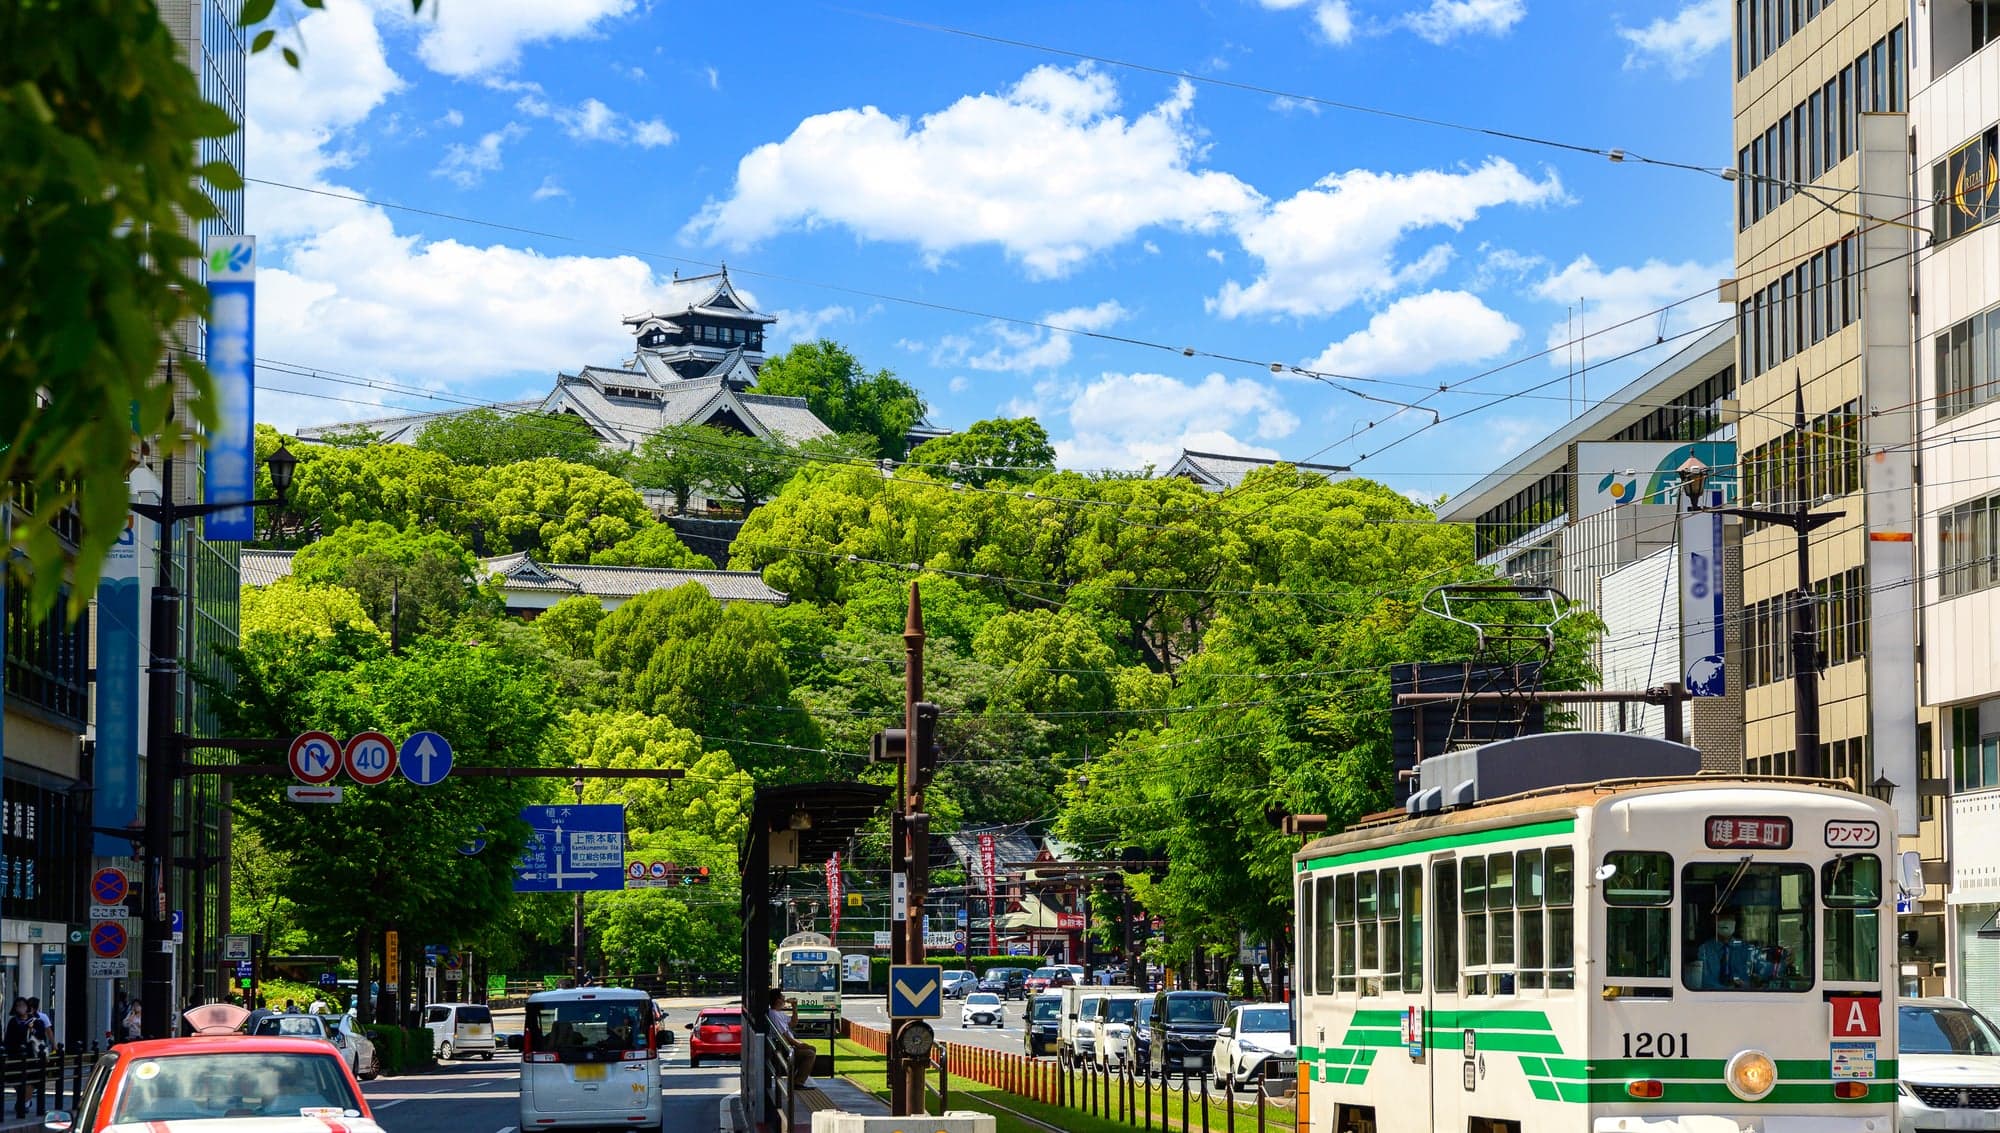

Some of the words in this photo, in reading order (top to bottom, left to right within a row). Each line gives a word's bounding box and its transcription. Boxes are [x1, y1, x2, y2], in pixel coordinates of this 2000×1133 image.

[356, 747, 385, 769] 40
[574, 833, 618, 844] 上熊本駅
[1711, 820, 1786, 845] 健軍町
[1828, 827, 1876, 842] ワンマン
[92, 908, 127, 918] ここまで
[92, 961, 126, 969] ここから
[1846, 1001, 1867, 1032] A
[1622, 1032, 1690, 1058] 1201
